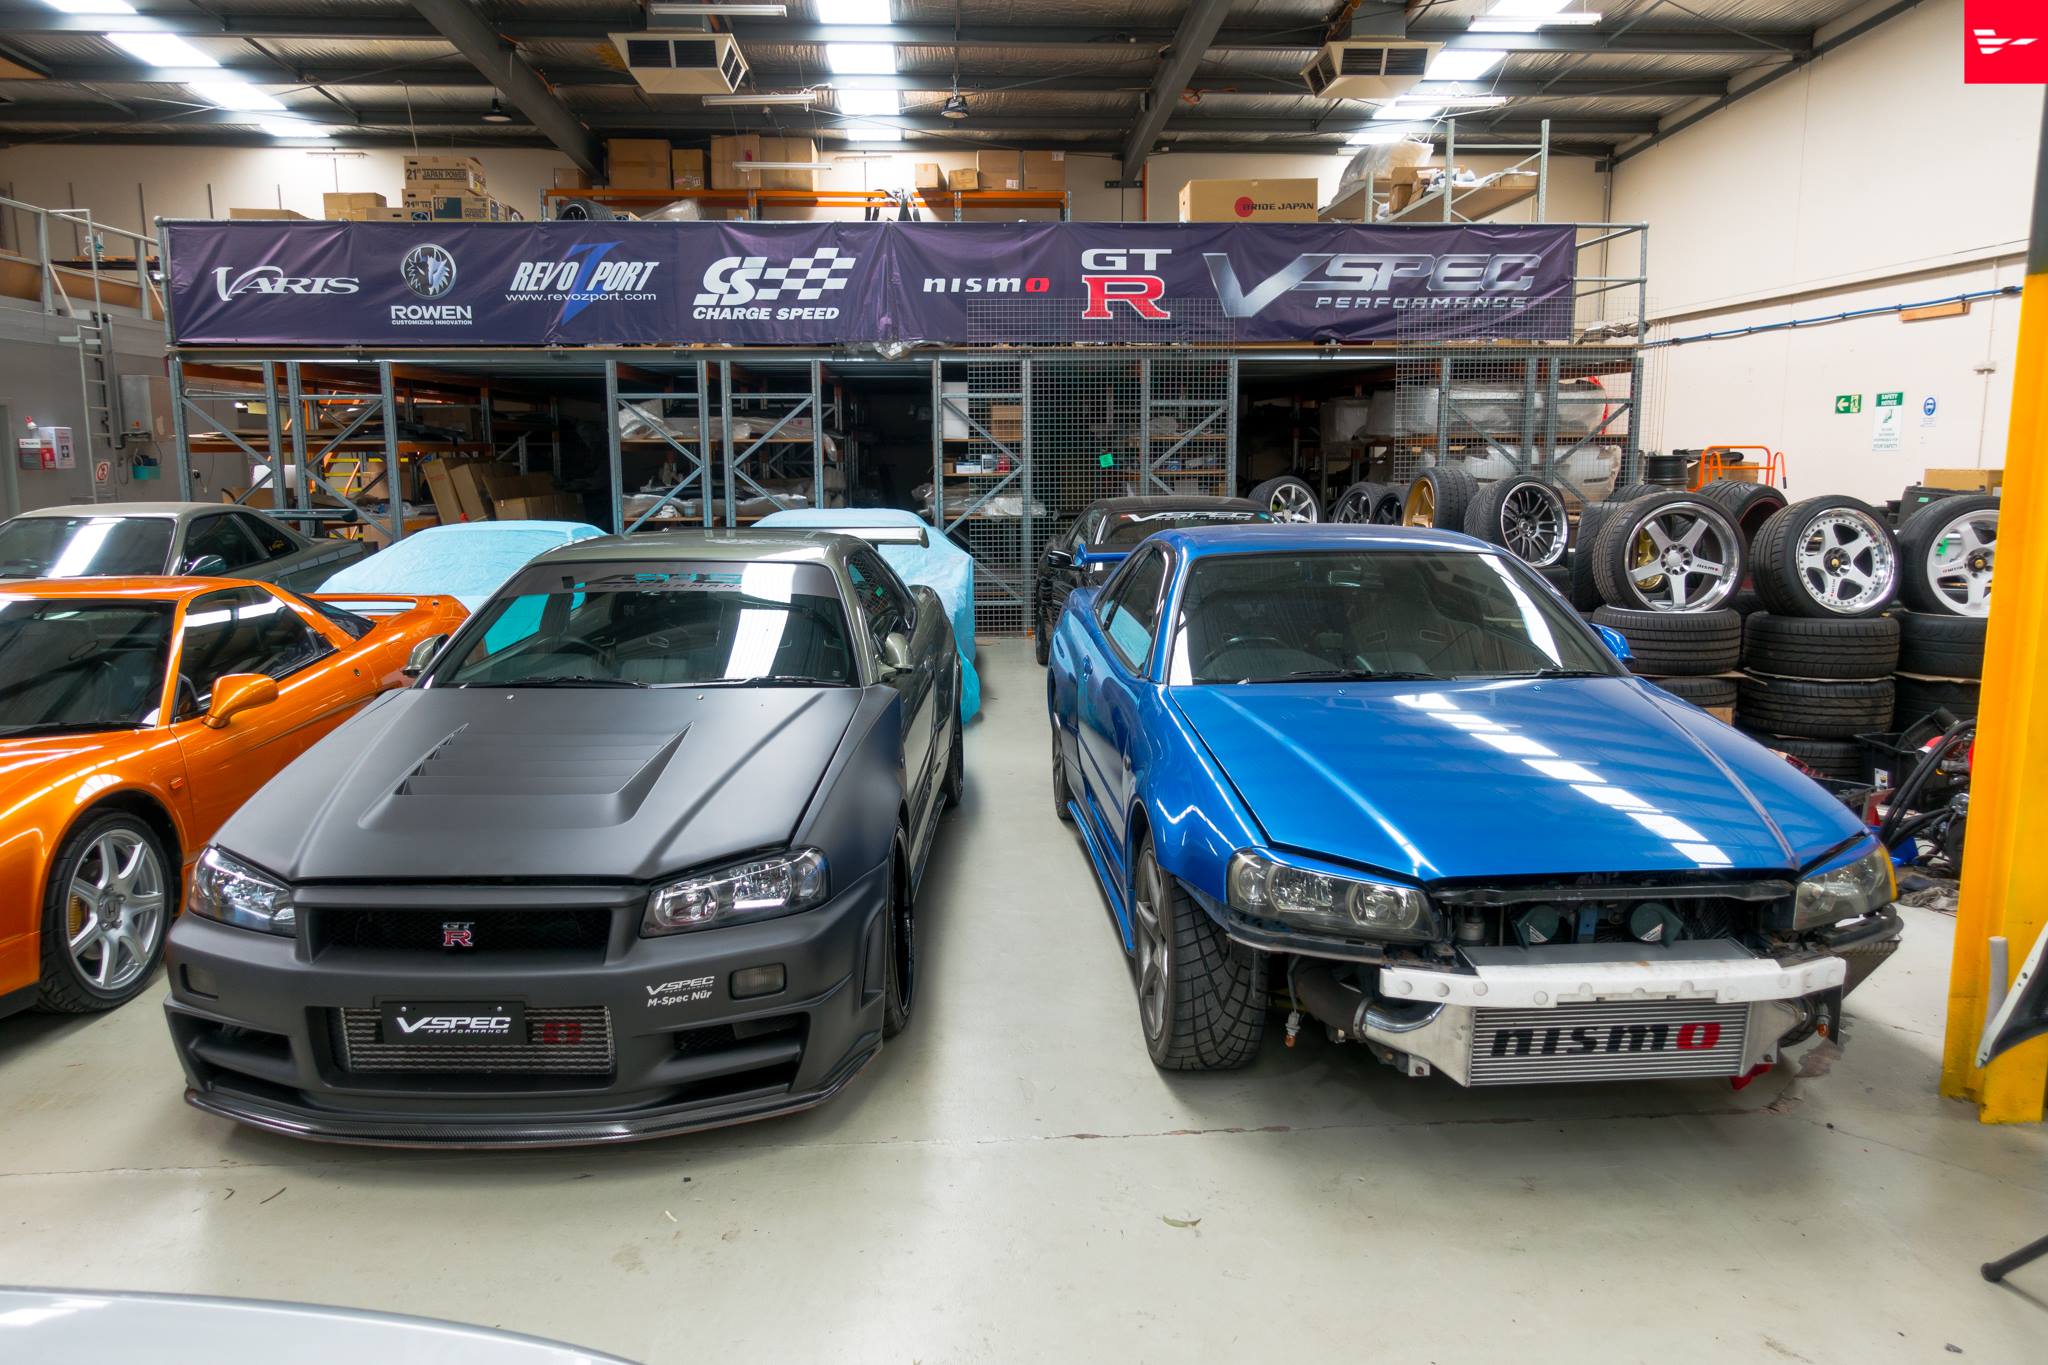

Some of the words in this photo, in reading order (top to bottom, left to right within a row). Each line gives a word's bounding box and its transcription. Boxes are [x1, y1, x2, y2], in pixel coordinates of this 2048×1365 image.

[423, 169, 444, 179] JAPAN
[1243, 203, 1276, 211] BRIDE
[1278, 202, 1314, 210] JAPAN
[1081, 248, 1172, 271] GT
[505, 292, 657, 303] www.revozport.com
[1081, 274, 1171, 320] R
[1315, 296, 1528, 309] PERFORMANCE
[391, 305, 472, 319] ROWEN
[693, 307, 772, 320] CHARGE
[776, 307, 840, 320] SPEED
[442, 921, 476, 930] GT
[442, 929, 473, 947] R
[647, 994, 689, 1008] M-Spec
[691, 989, 713, 1001] Nür
